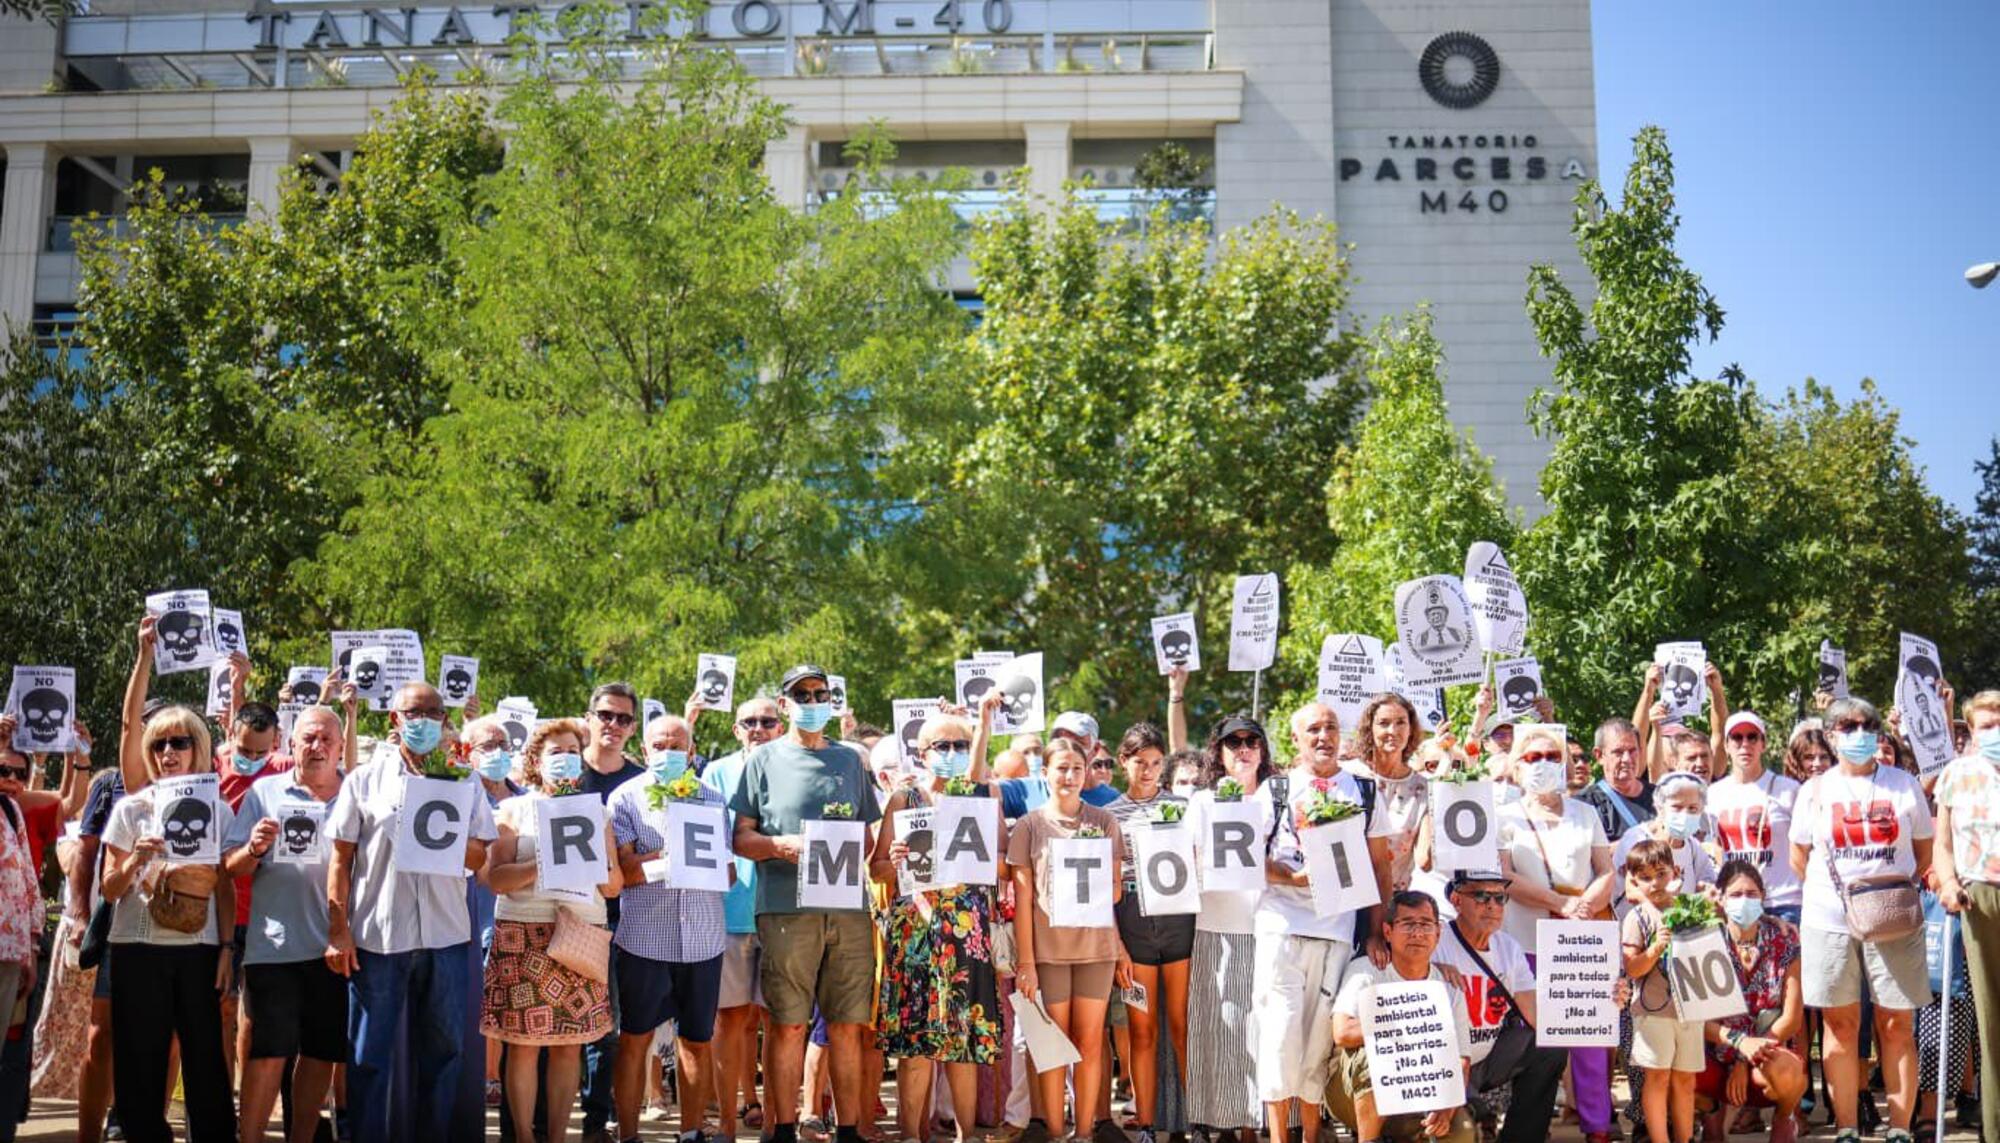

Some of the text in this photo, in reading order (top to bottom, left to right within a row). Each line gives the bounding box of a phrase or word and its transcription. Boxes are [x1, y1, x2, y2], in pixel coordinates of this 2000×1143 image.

[1388, 135, 1537, 149] TANATORIO
[1340, 156, 1587, 182] PARCESA
[1420, 189, 1508, 214] M40
[167, 600, 186, 610] NO
[971, 668, 986, 676] NO
[1509, 667, 1524, 675] NO
[34, 677, 54, 686] NO
[510, 712, 522, 721] NO
[909, 709, 925, 718] NO
[175, 787, 194, 797] NO
[413, 800, 461, 850] C
[910, 819, 928, 829] NO
[1443, 800, 1488, 847] O
[1718, 805, 1771, 851] NO
[1831, 799, 1898, 848] NO
[549, 815, 598, 865] R
[684, 821, 718, 869] E
[943, 816, 991, 863] A
[1212, 820, 1257, 868] R
[808, 840, 861, 887] M
[1330, 841, 1353, 889] I
[1063, 857, 1102, 904] T
[1146, 850, 1189, 896] O
[1557, 934, 1603, 945] Justicia
[1552, 952, 1608, 963] ambiental
[1550, 971, 1610, 983] para todos
[1672, 950, 1735, 1003] NO
[1376, 992, 1428, 1007] Justicia
[1548, 988, 1610, 999] los barrios.
[1374, 1005, 1437, 1024] ambiental
[1565, 1006, 1596, 1019] ¡No al
[1373, 1021, 1443, 1043] para todos
[1546, 1024, 1613, 1036] crematorio!
[1375, 1039, 1447, 1055] los barrios.
[1395, 1053, 1434, 1071] ¡No Al
[1380, 1067, 1454, 1087] Crematorio
[1401, 1085, 1437, 1100] M40!
